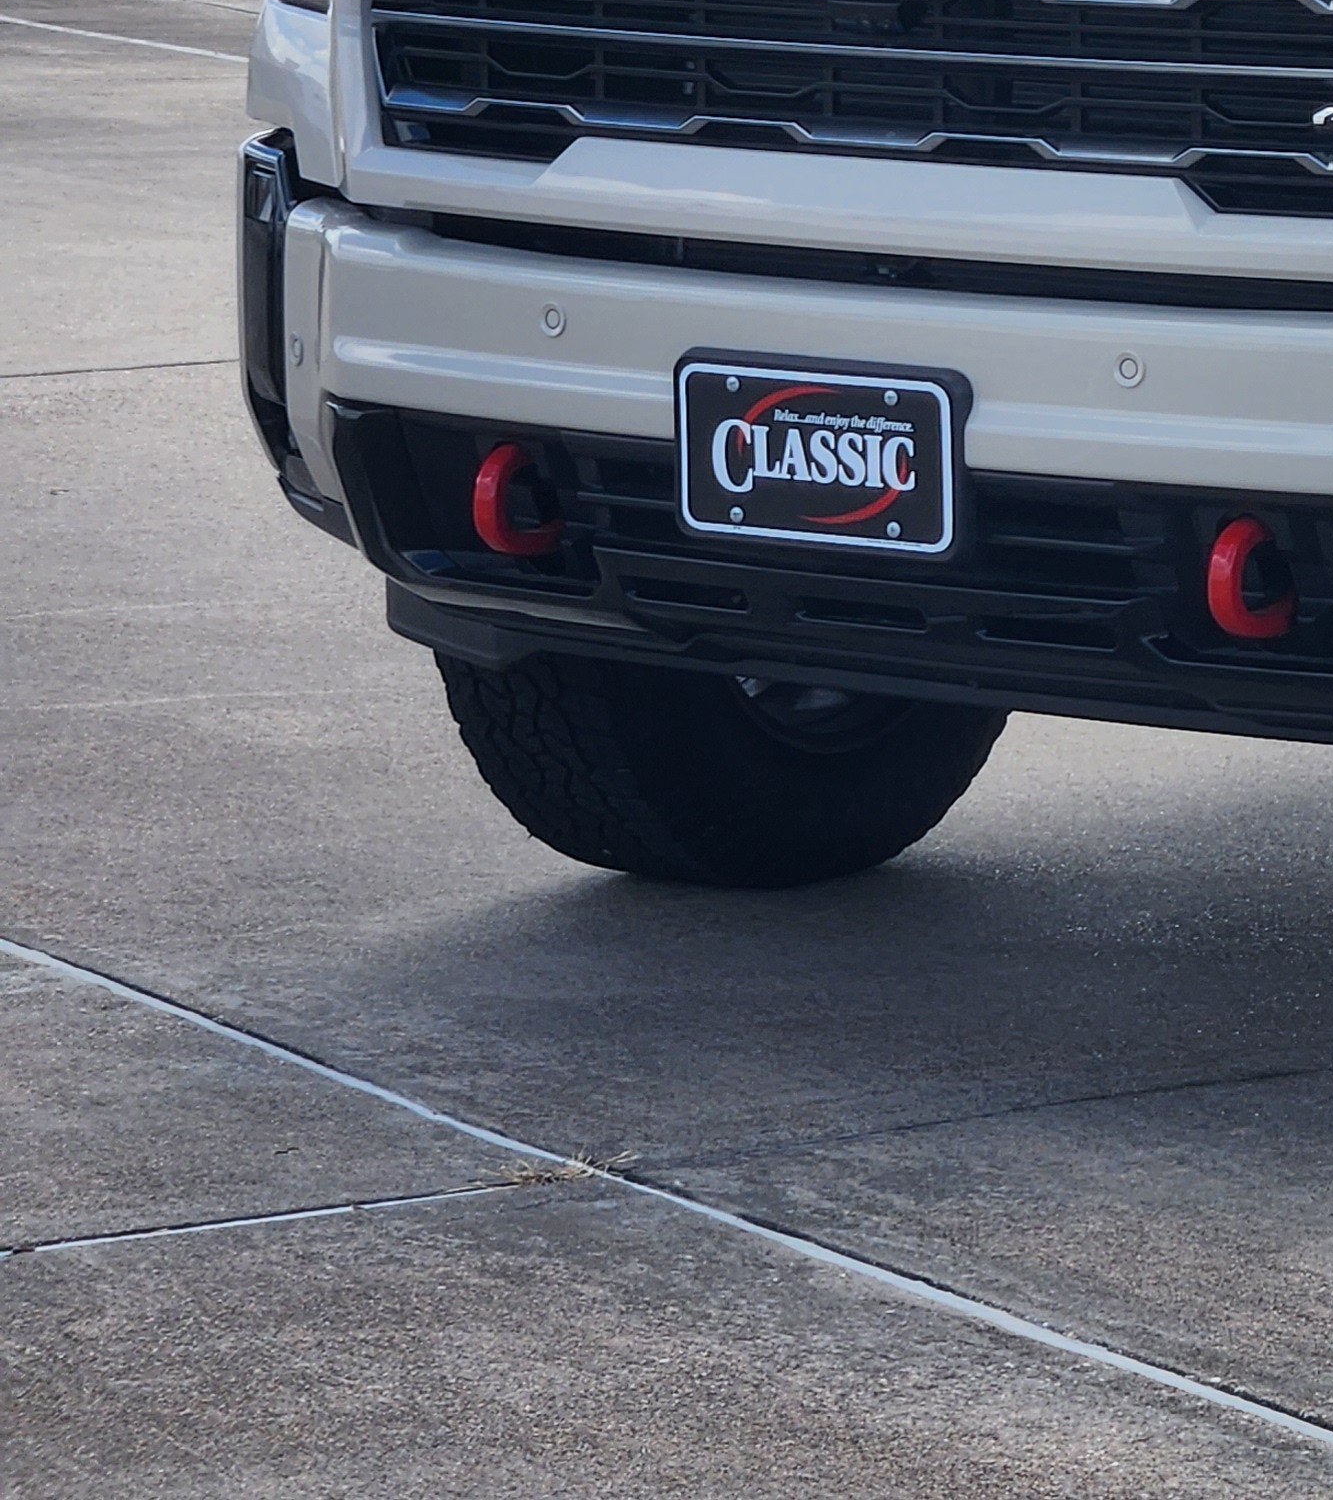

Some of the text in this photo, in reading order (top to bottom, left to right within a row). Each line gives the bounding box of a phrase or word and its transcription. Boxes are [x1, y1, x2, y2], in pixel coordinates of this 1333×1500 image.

[824, 413, 850, 430] enjoy
[850, 414, 866, 429] the
[711, 418, 916, 493] CLASSIC
